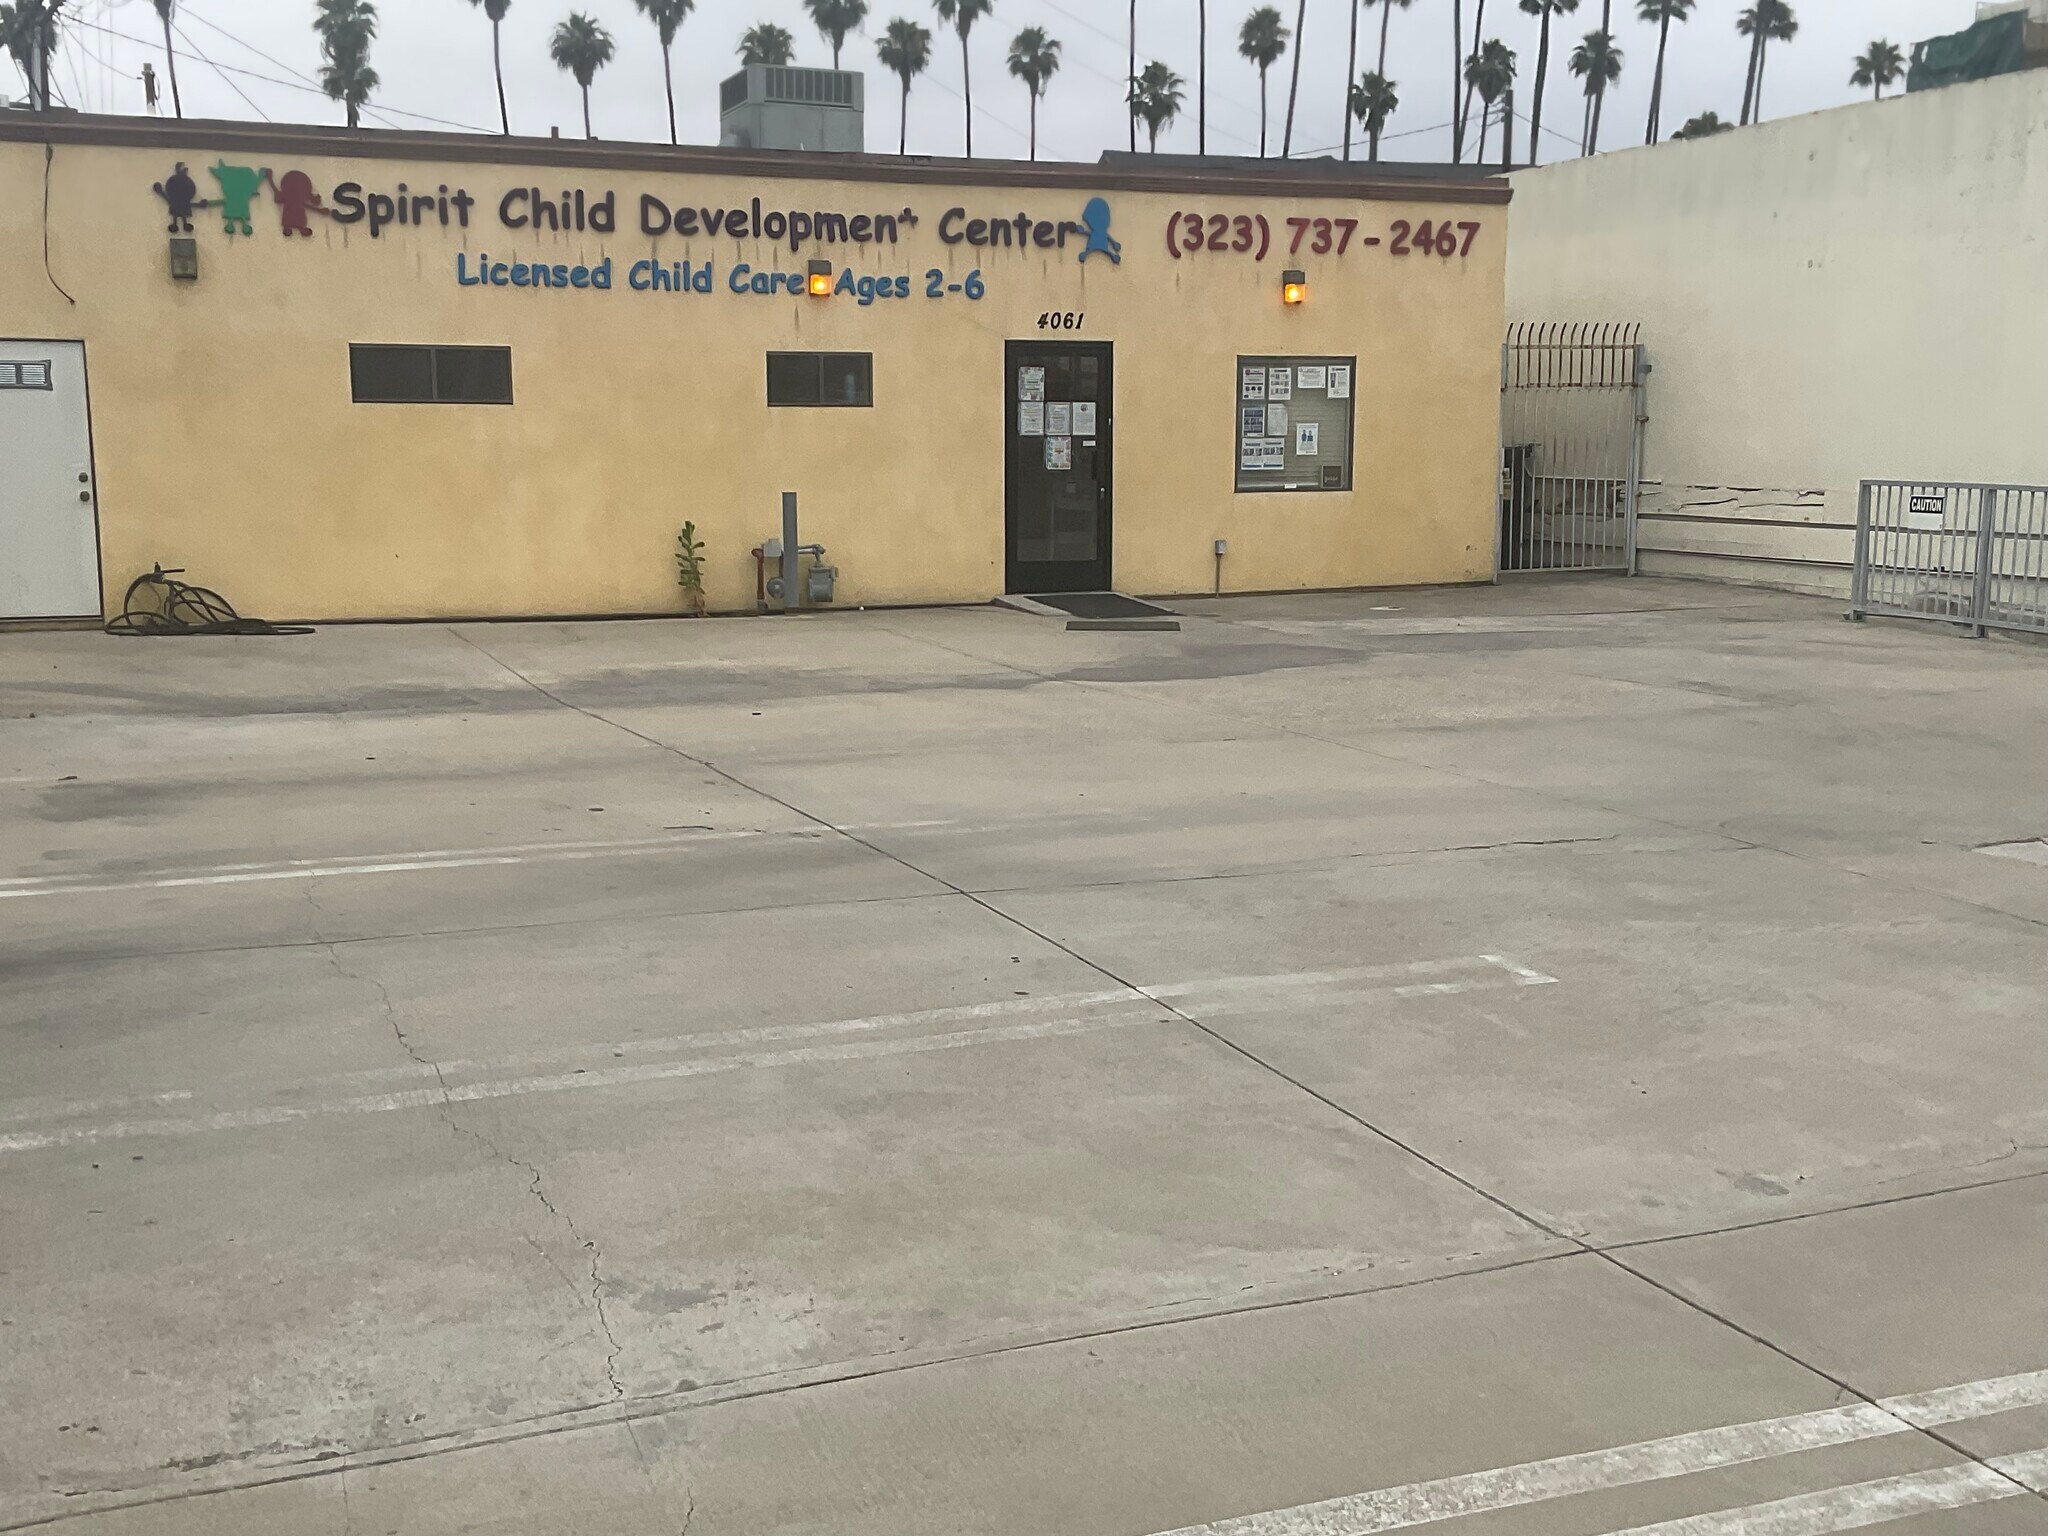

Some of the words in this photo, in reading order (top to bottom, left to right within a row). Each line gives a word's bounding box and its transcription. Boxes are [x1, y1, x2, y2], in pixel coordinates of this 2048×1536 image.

[330, 182, 474, 238] Spirit
[498, 187, 616, 234] Child
[938, 207, 1088, 250] Center
[1166, 210, 1270, 261] (323)
[457, 254, 612, 289] Licensed
[629, 260, 713, 292] Child
[729, 263, 805, 294] Care
[833, 269, 911, 305] Ages
[926, 269, 985, 299] 2-6
[1036, 311, 1085, 331] 4061
[1911, 498, 1942, 512] CAUTION
